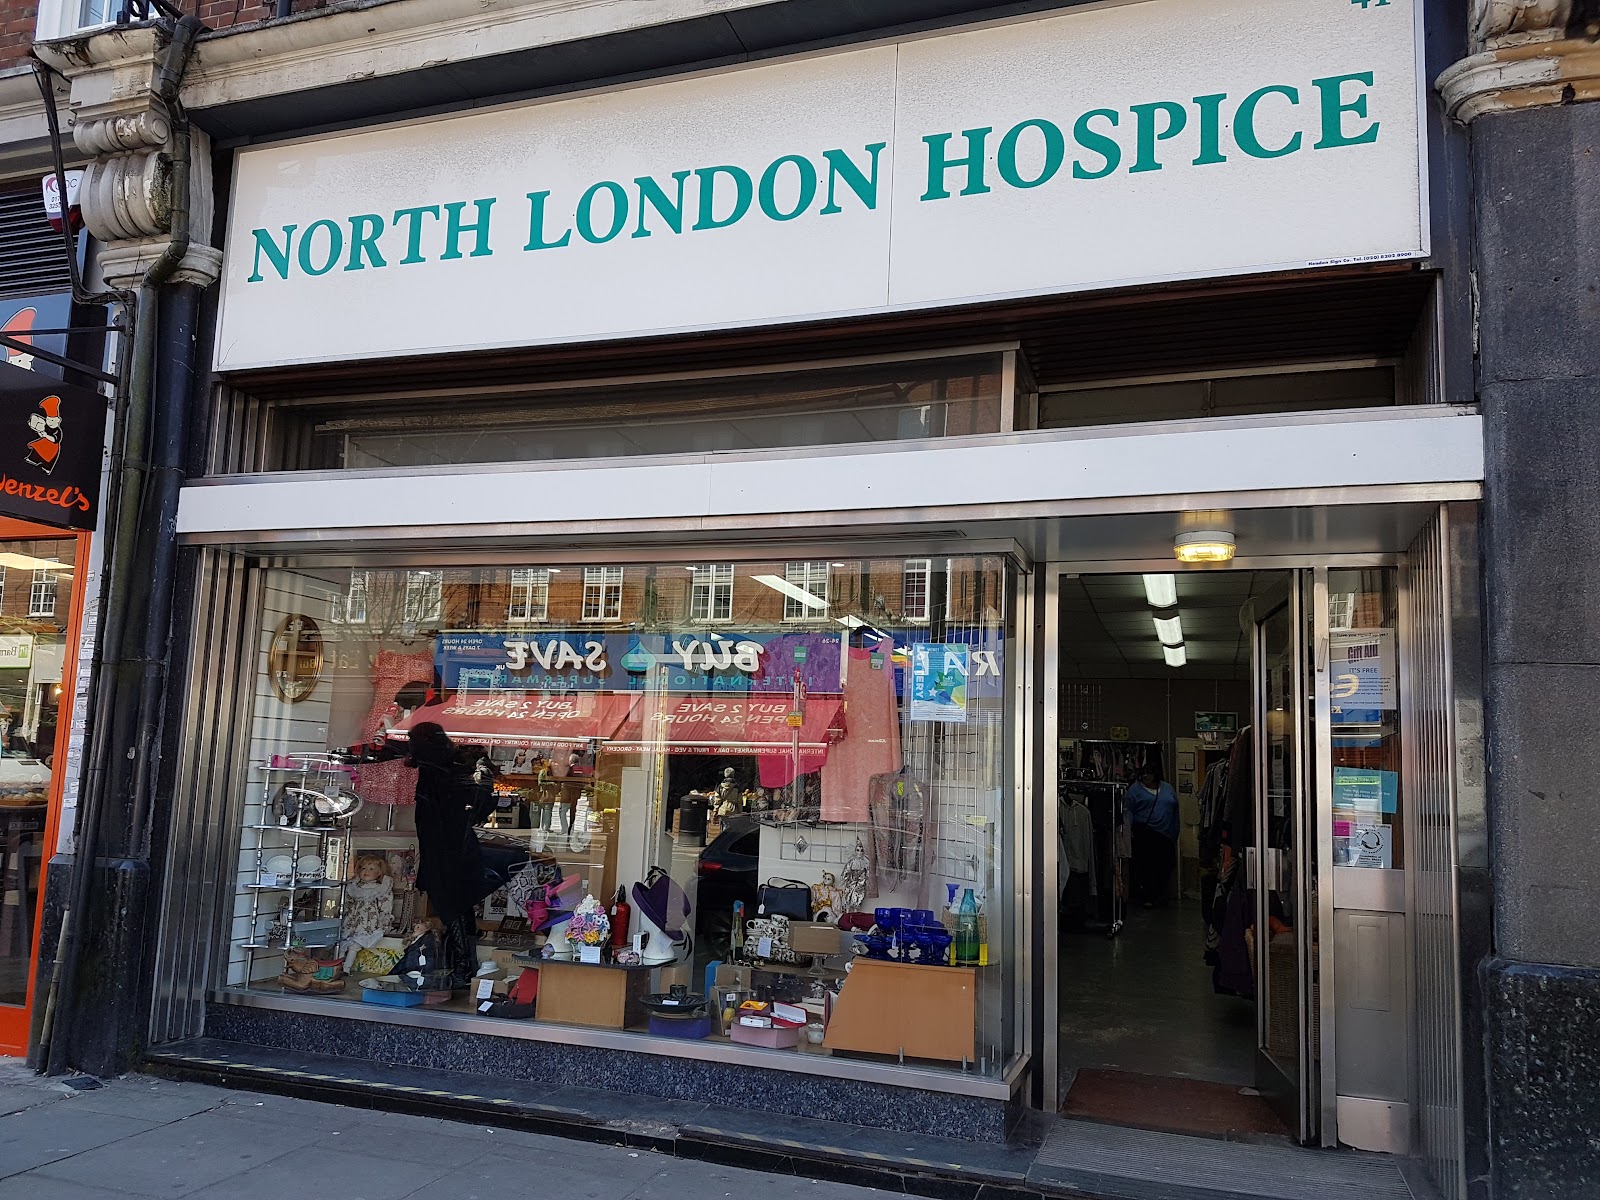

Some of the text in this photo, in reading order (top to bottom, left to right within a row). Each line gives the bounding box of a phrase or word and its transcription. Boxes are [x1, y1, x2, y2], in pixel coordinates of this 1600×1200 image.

[248, 72, 1379, 282] NORTH LONDON HOSPICE
[0, 472, 90, 511] enzel's
